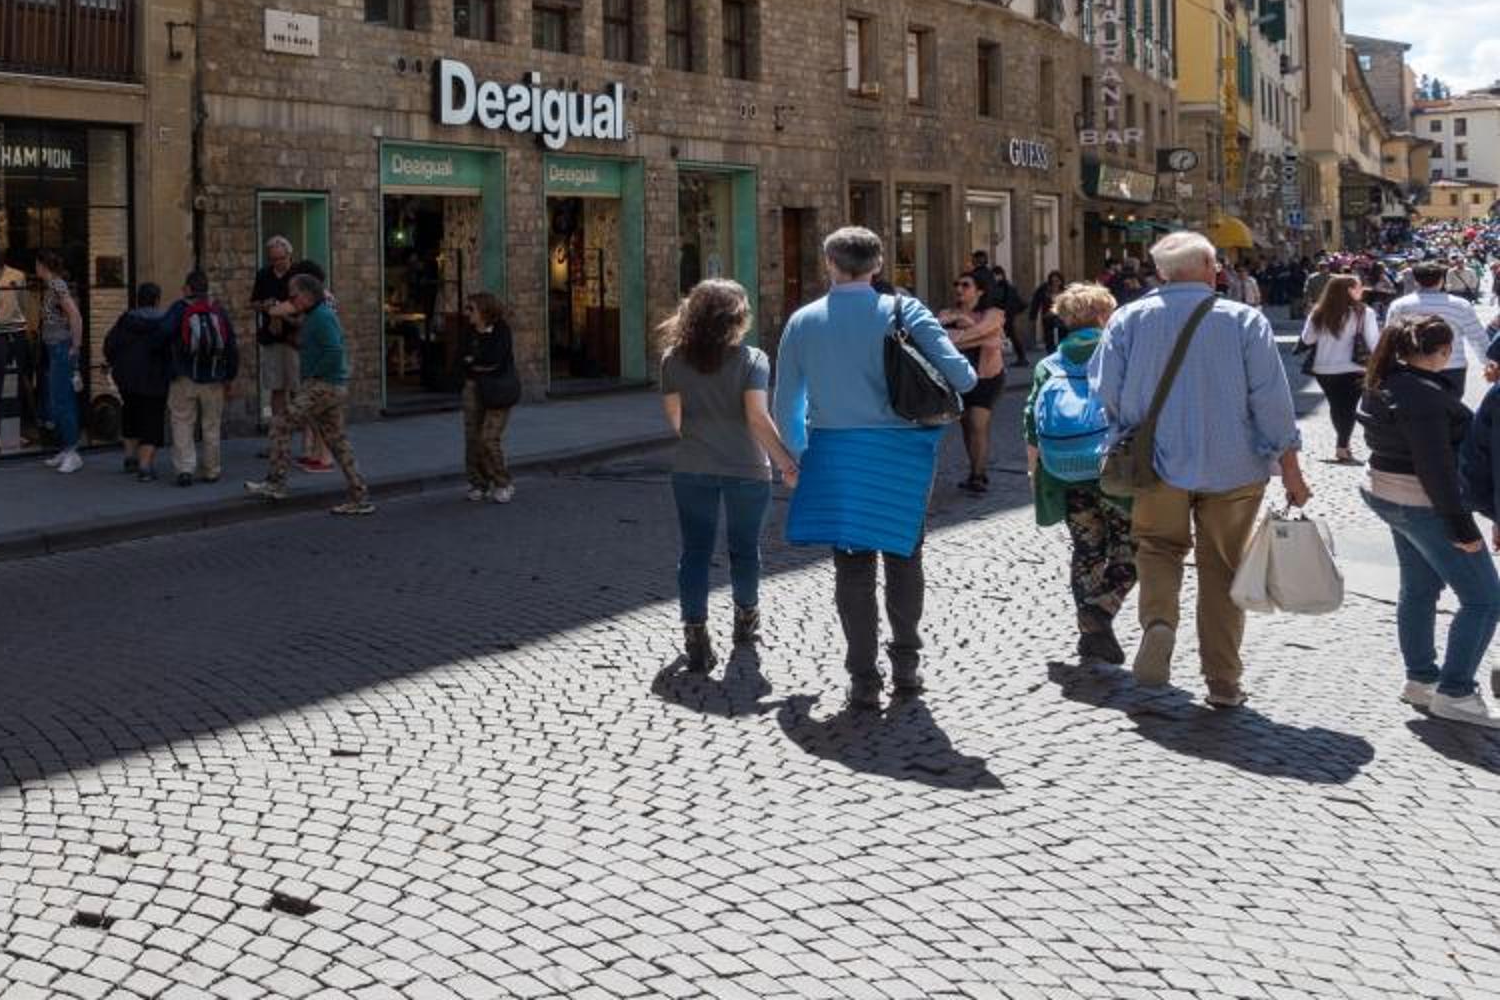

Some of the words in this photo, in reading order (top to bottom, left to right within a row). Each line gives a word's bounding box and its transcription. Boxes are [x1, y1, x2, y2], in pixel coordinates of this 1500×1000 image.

[440, 58, 623, 149] Desigual
[1079, 129, 1143, 145] BAR
[1010, 137, 1048, 169] GUESS
[391, 154, 453, 179] Desigual
[548, 164, 598, 186] Desigual
